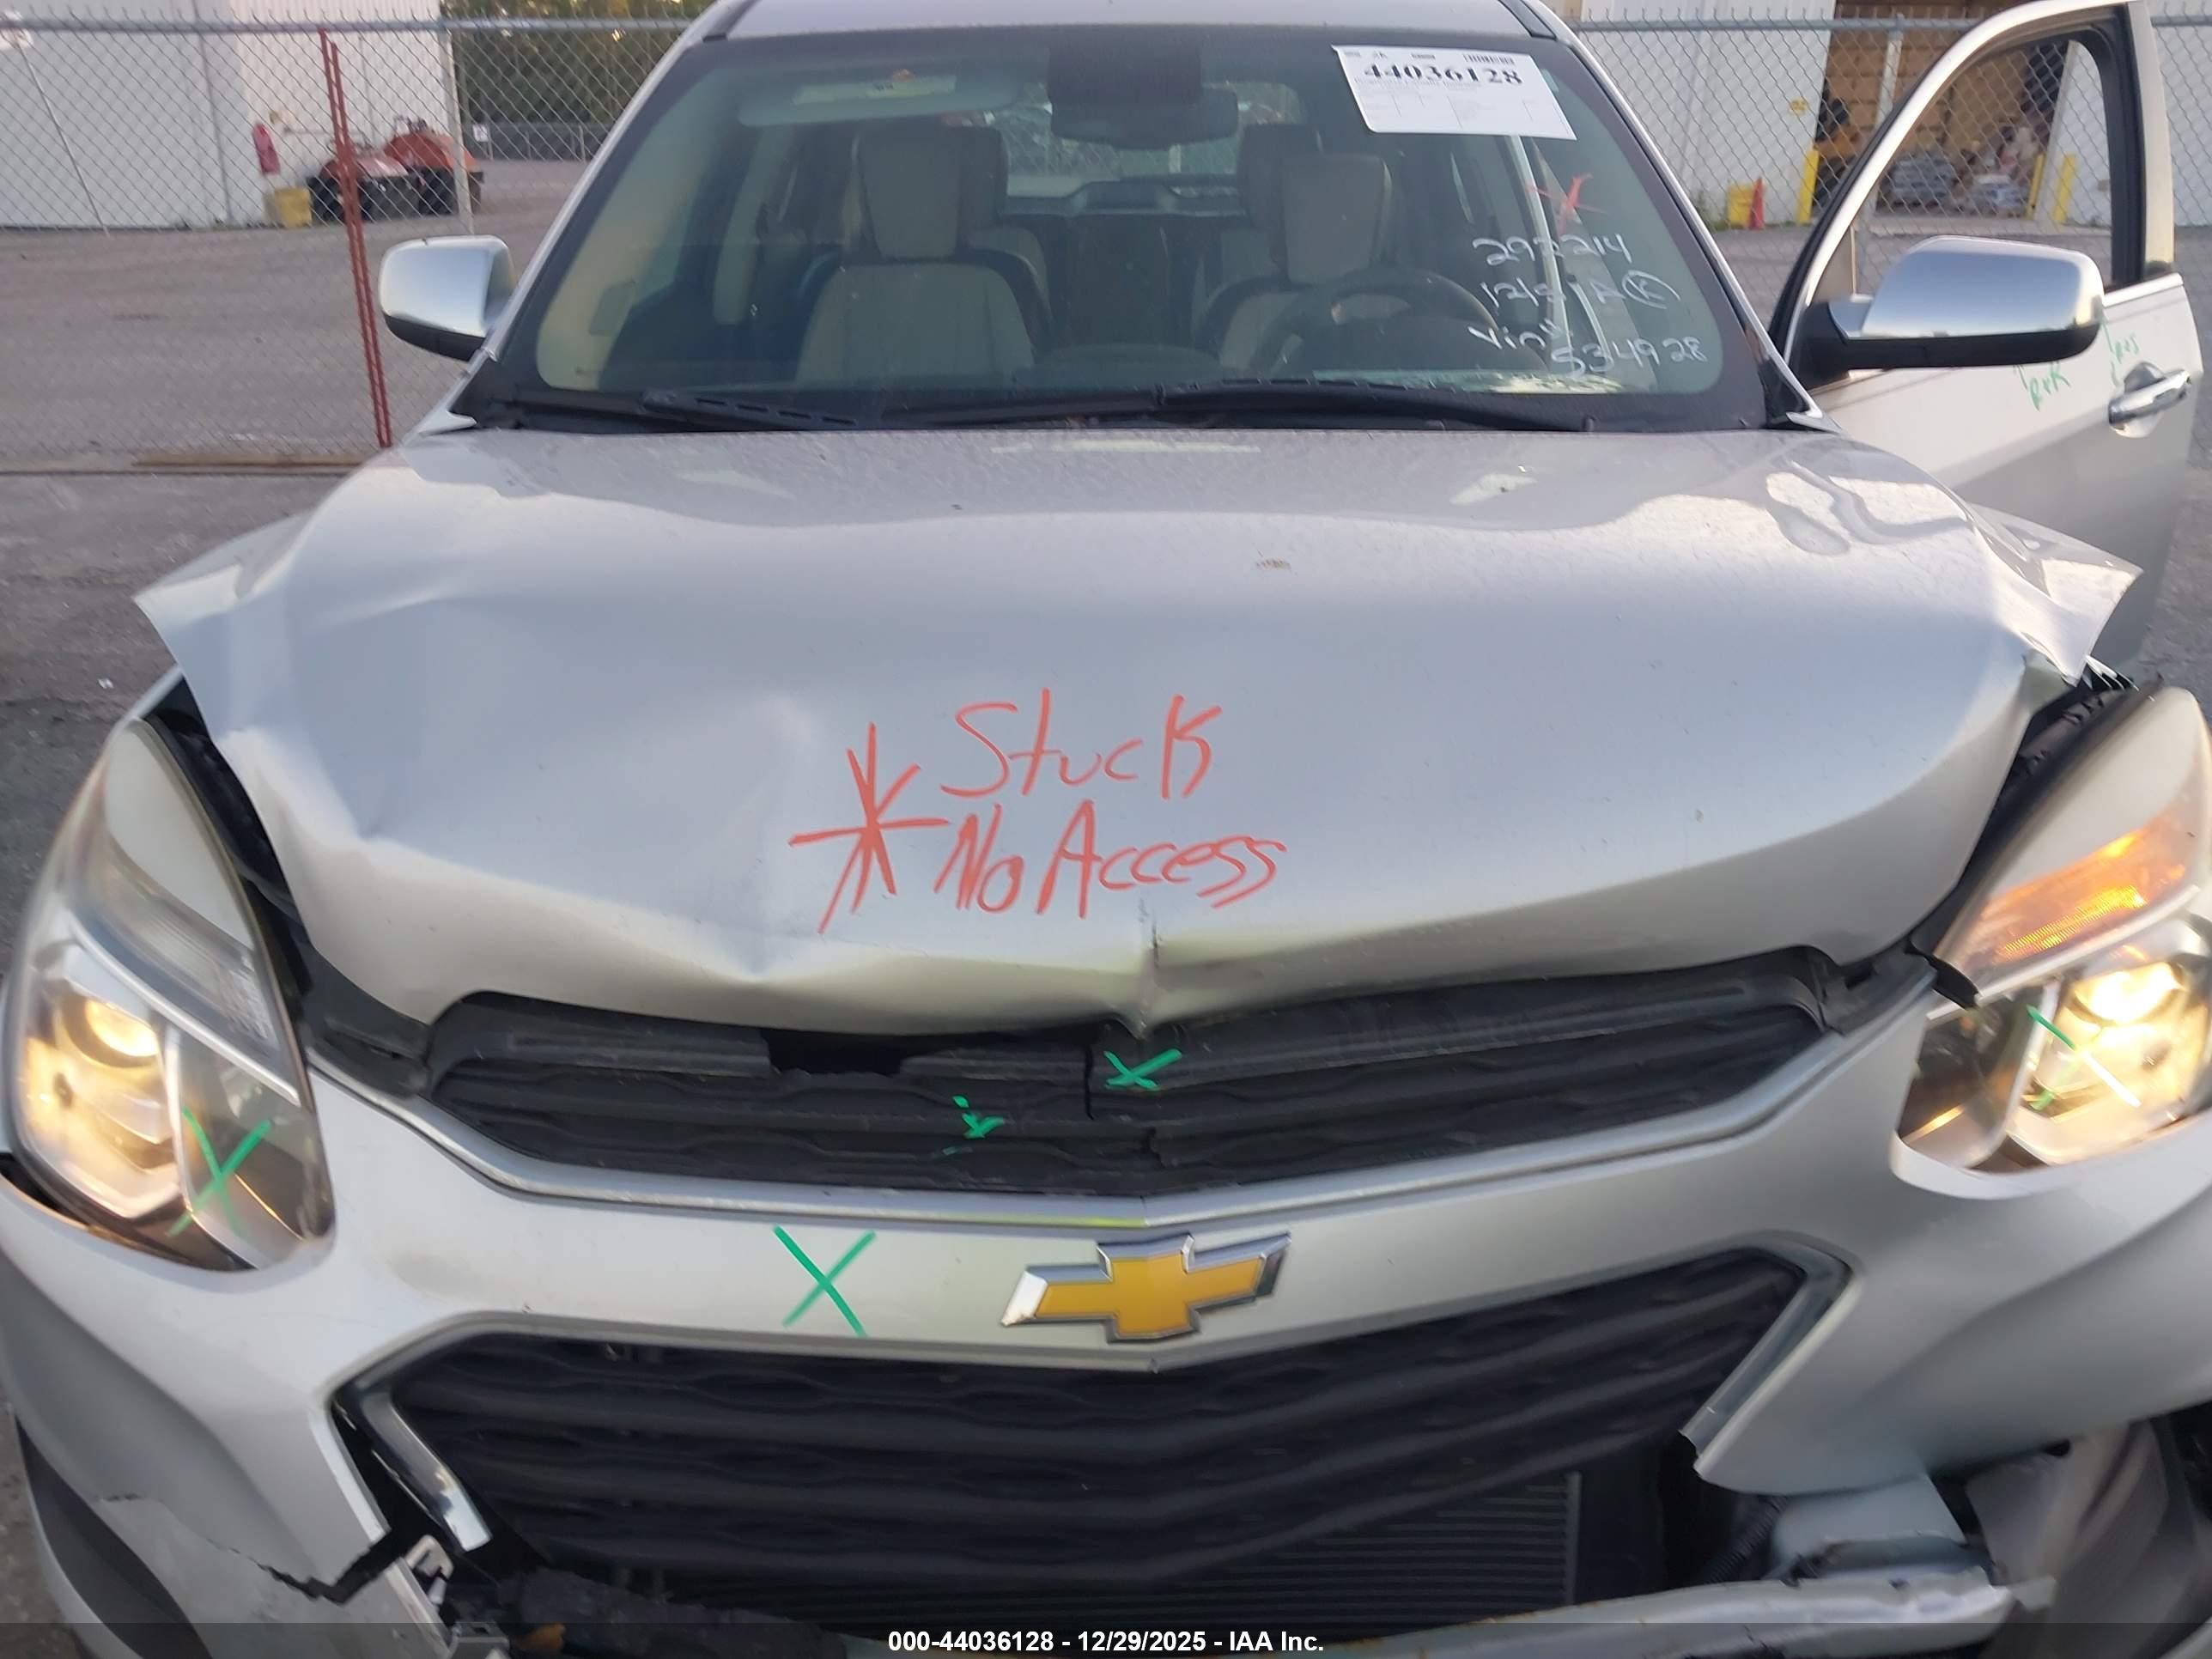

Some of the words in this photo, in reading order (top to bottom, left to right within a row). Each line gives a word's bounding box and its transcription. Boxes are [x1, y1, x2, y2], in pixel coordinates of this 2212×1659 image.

[1364, 63, 1523, 85] 44036128
[933, 804, 1024, 913] No
[1036, 799, 1287, 919] Access
